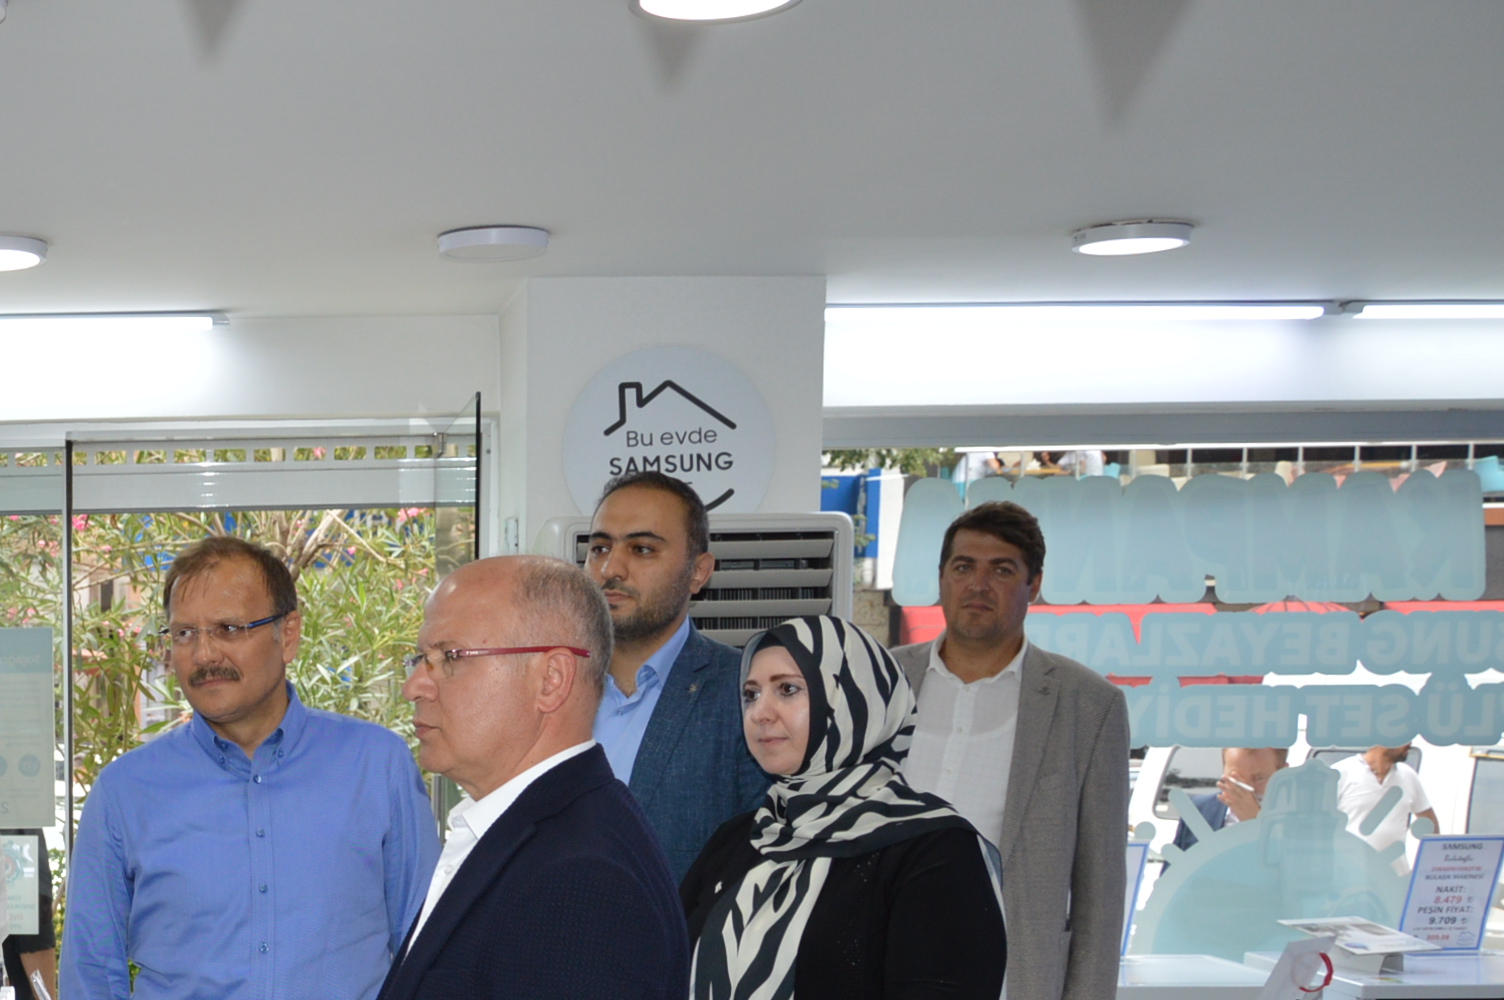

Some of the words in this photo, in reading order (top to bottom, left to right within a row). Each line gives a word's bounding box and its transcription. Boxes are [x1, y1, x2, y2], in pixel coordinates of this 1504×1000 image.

[626, 430, 653, 448] Bu
[660, 426, 718, 446] evde
[609, 451, 734, 476] SAMSUNG
[1435, 885, 1466, 893] NAKİT:
